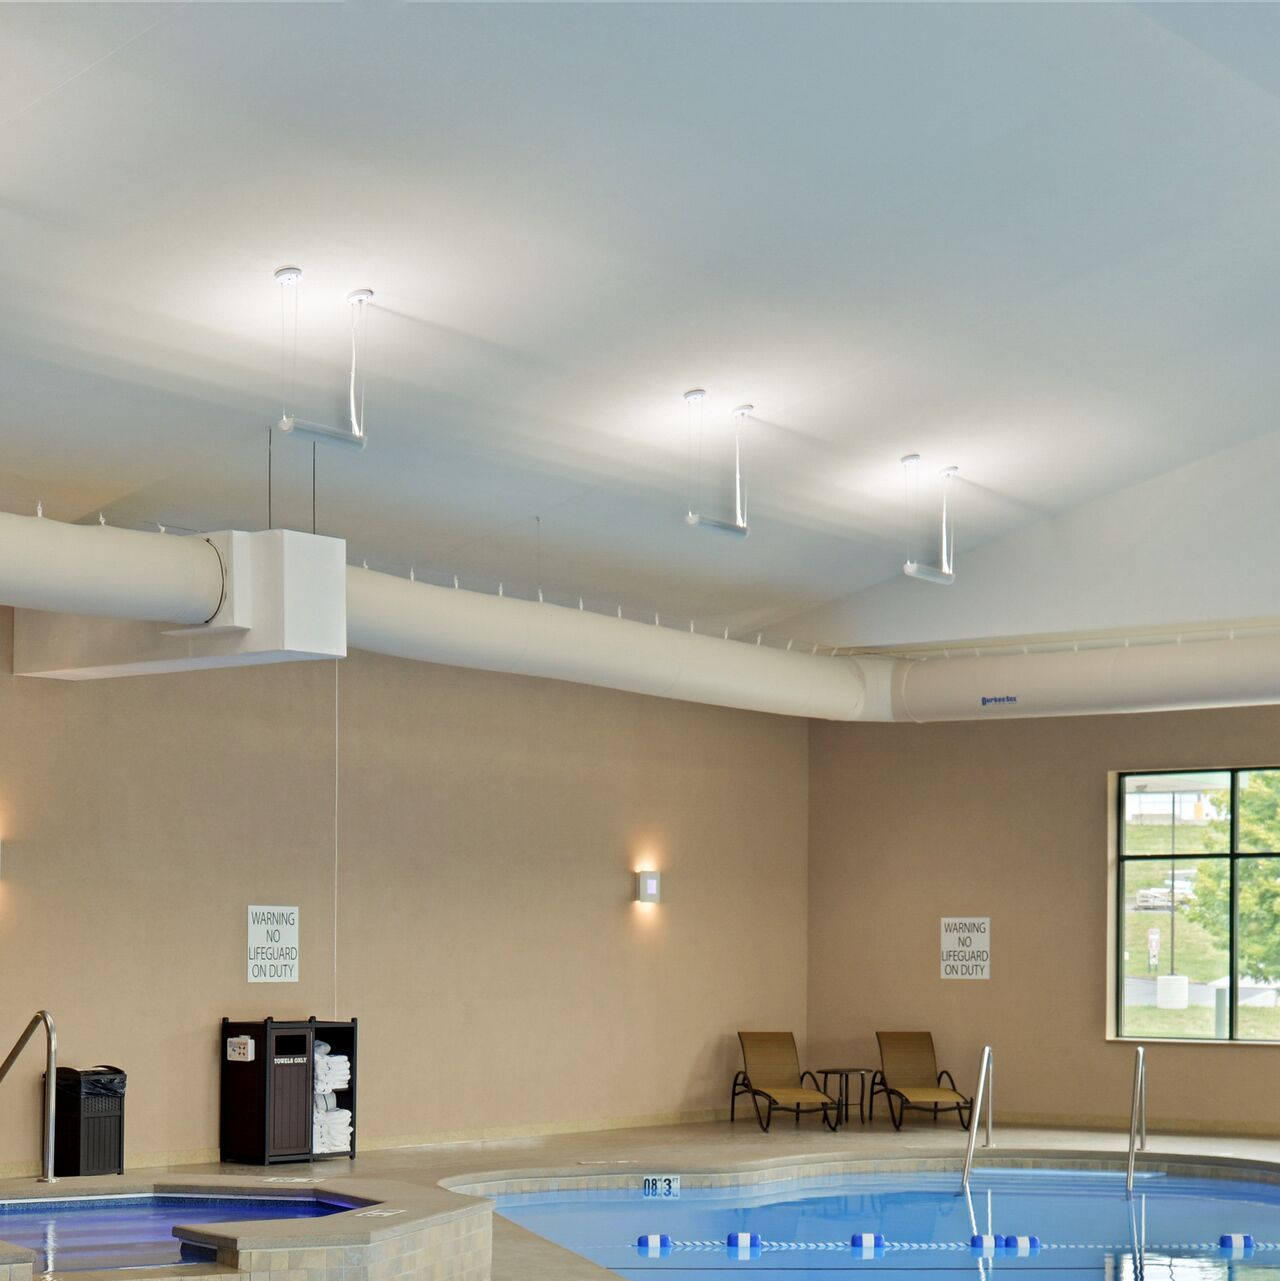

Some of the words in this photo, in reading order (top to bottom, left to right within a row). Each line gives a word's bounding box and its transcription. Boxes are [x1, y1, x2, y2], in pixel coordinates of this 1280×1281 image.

[251, 911, 295, 926] WARNING
[944, 922, 986, 934] WARNING
[266, 929, 281, 943] NO
[958, 936, 972, 948] NO
[248, 946, 298, 961] LIFEGUARD
[941, 950, 989, 962] LIFEGUARD
[251, 963, 267, 978] ON
[269, 964, 295, 978] DUTY
[944, 964, 959, 976] ON
[961, 964, 985, 976] DUTY
